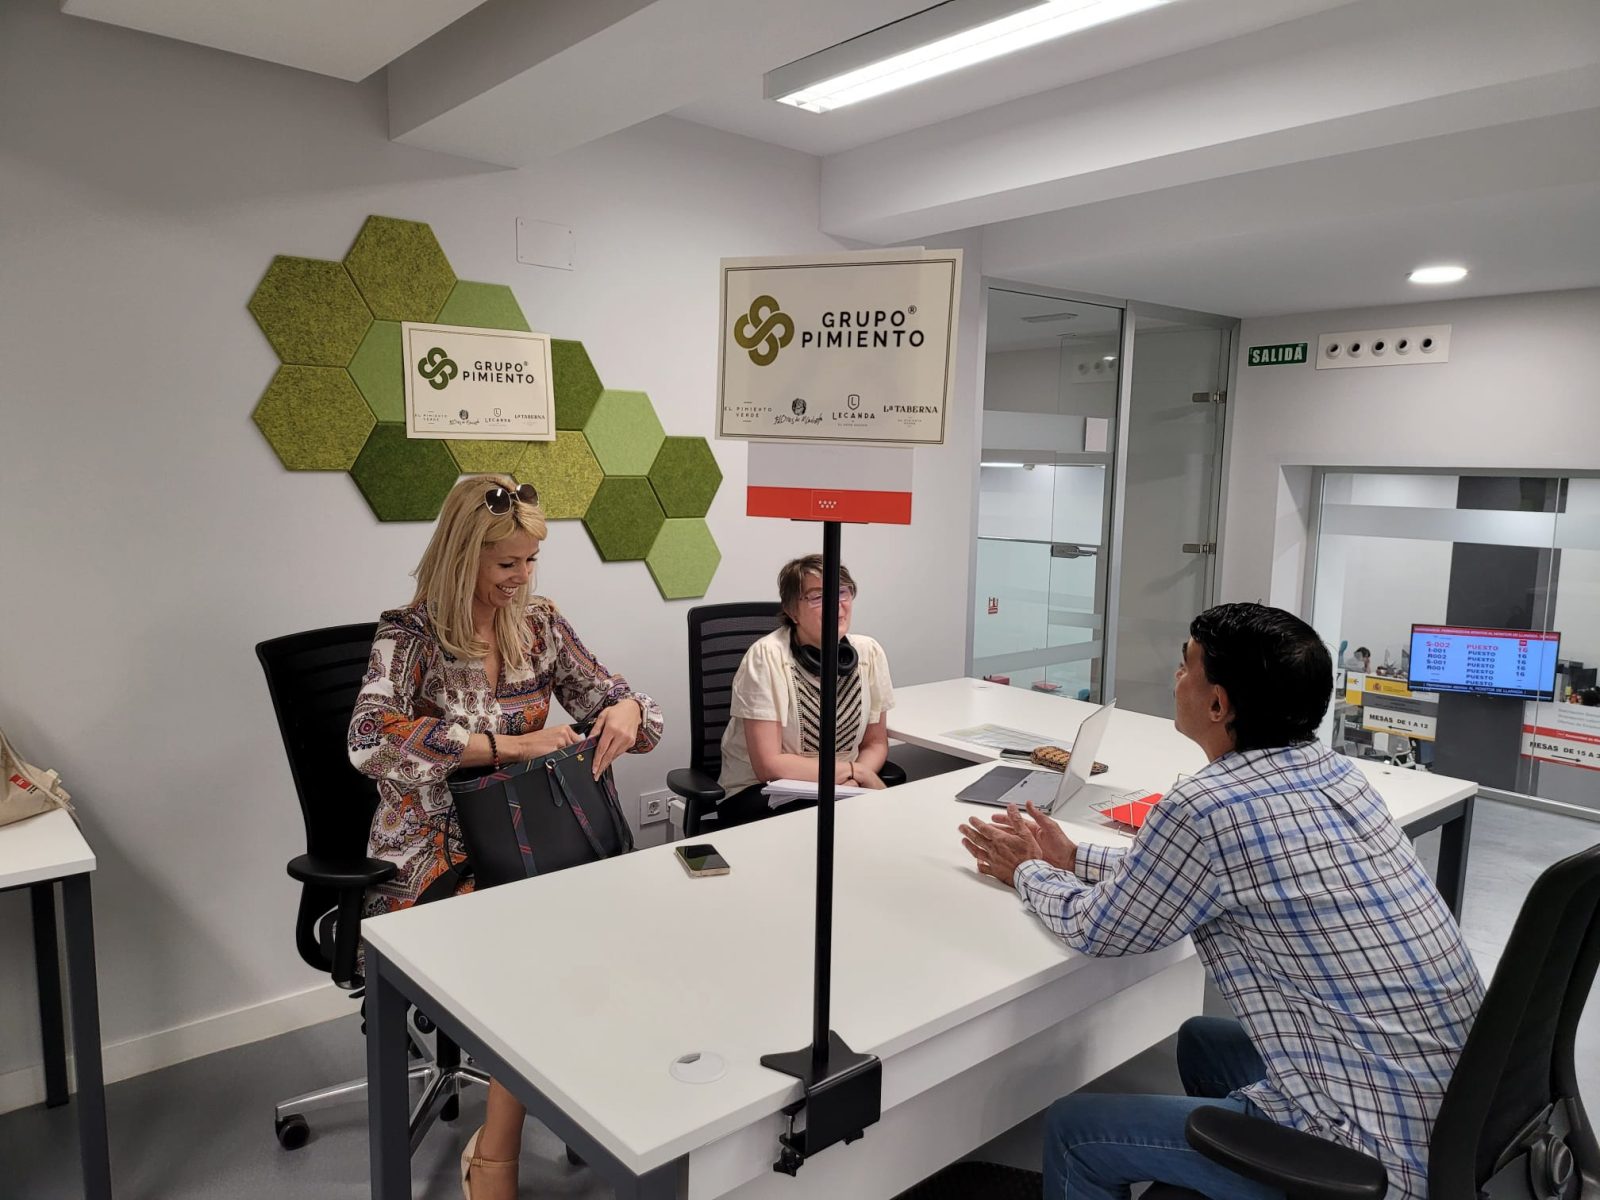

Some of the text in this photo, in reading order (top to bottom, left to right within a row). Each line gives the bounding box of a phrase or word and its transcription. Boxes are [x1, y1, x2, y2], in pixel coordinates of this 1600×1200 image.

[801, 330, 925, 348] PIMIENTO
[1252, 347, 1303, 363] SALIDA
[462, 371, 535, 384] PIMIENTO
[895, 405, 938, 414] TABERNA
[832, 412, 876, 421] LECANDA
[1465, 679, 1493, 687] PUESTO
[1369, 712, 1393, 723] MESAS
[1529, 741, 1559, 752] MESAS
